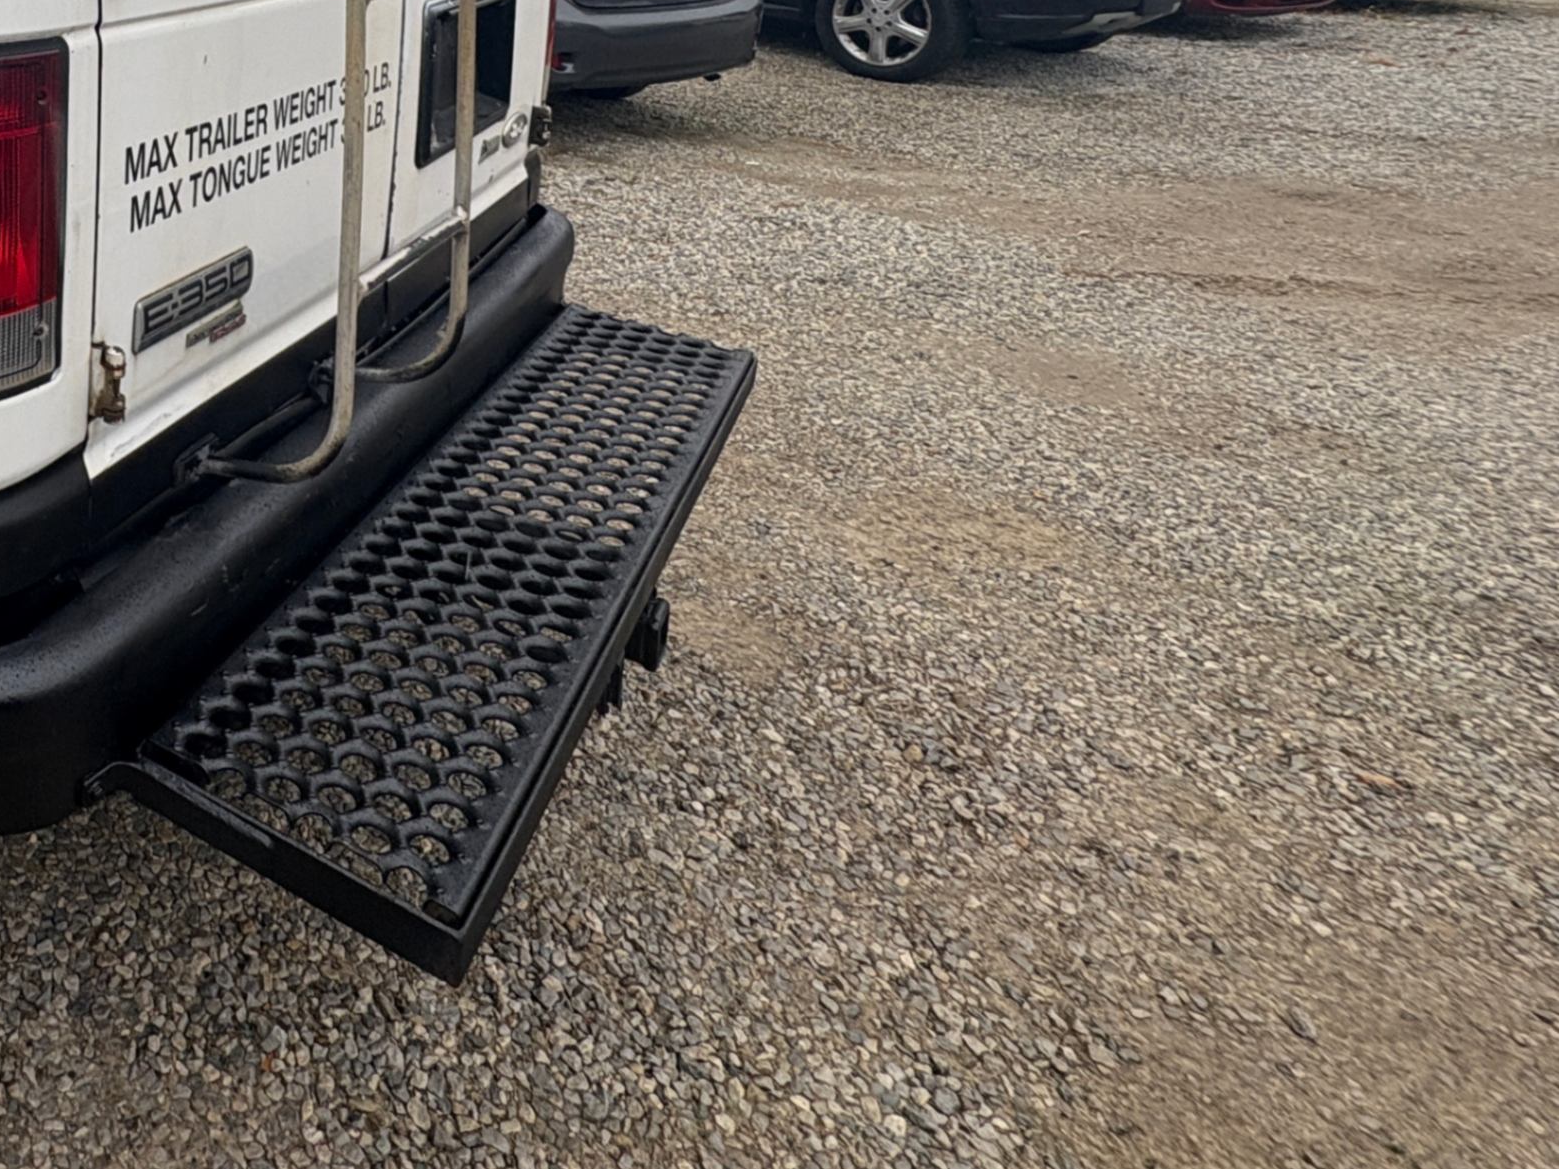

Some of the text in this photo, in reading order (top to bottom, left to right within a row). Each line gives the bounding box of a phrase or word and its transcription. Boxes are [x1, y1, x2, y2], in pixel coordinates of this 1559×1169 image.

[124, 131, 180, 185] MAX
[185, 103, 269, 163] TRAILER
[273, 79, 338, 131] WEIGHT
[373, 61, 392, 93] LB.
[129, 178, 184, 233] MAX
[189, 144, 272, 208] TONGUE
[275, 118, 339, 172] WEIGHT
[367, 100, 386, 132] LB.
[142, 252, 253, 335] E-350
